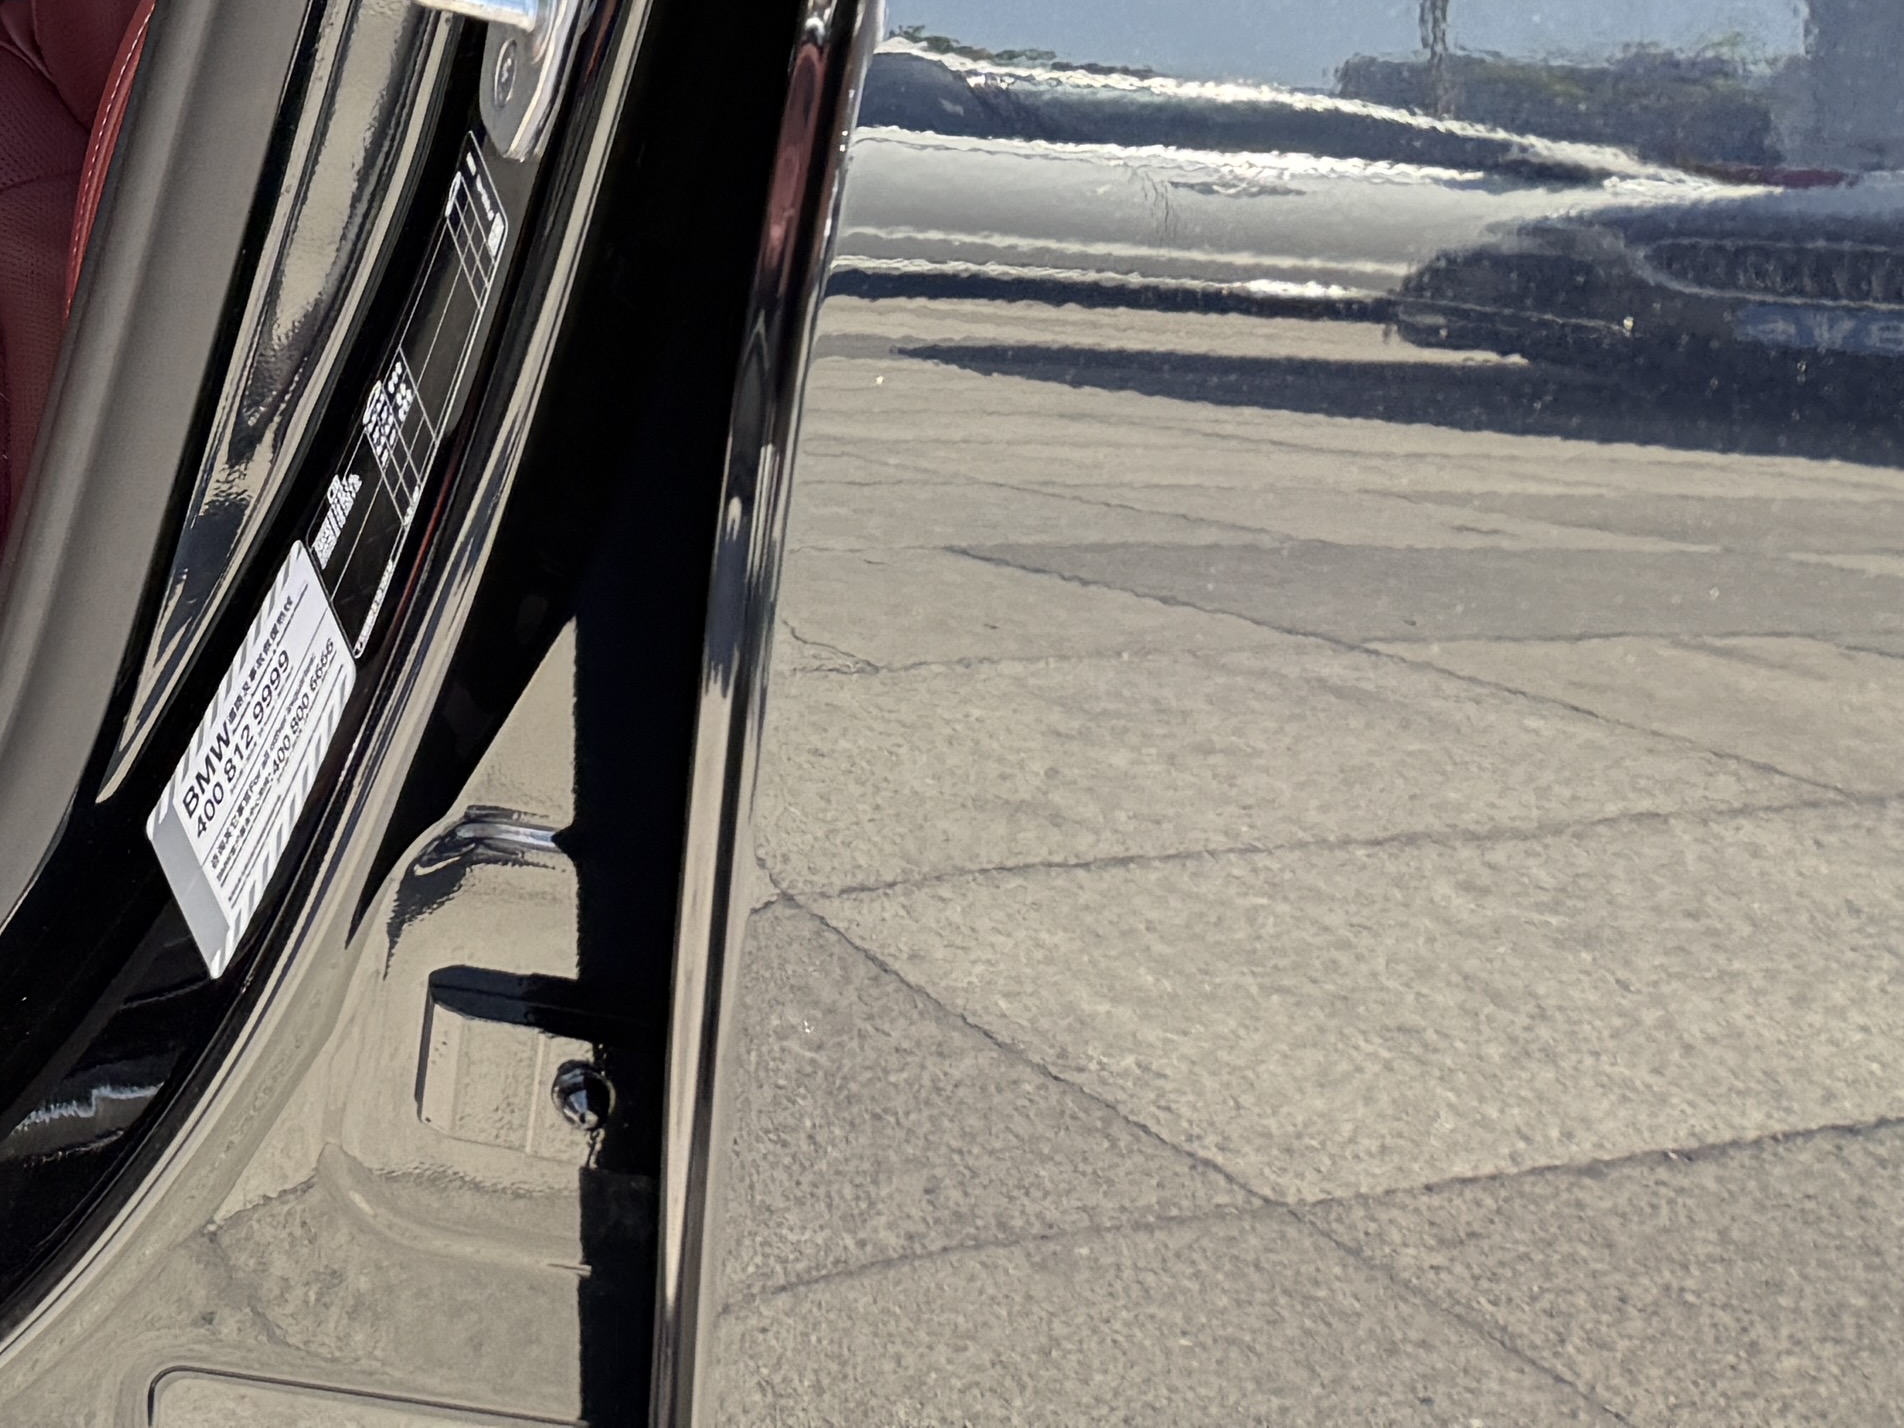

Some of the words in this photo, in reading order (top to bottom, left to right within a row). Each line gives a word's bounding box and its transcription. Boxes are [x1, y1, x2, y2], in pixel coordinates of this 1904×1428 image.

[182, 722, 231, 819] BMW
[196, 782, 225, 839] 400
[224, 724, 254, 782] 812
[252, 649, 290, 726] 9999
